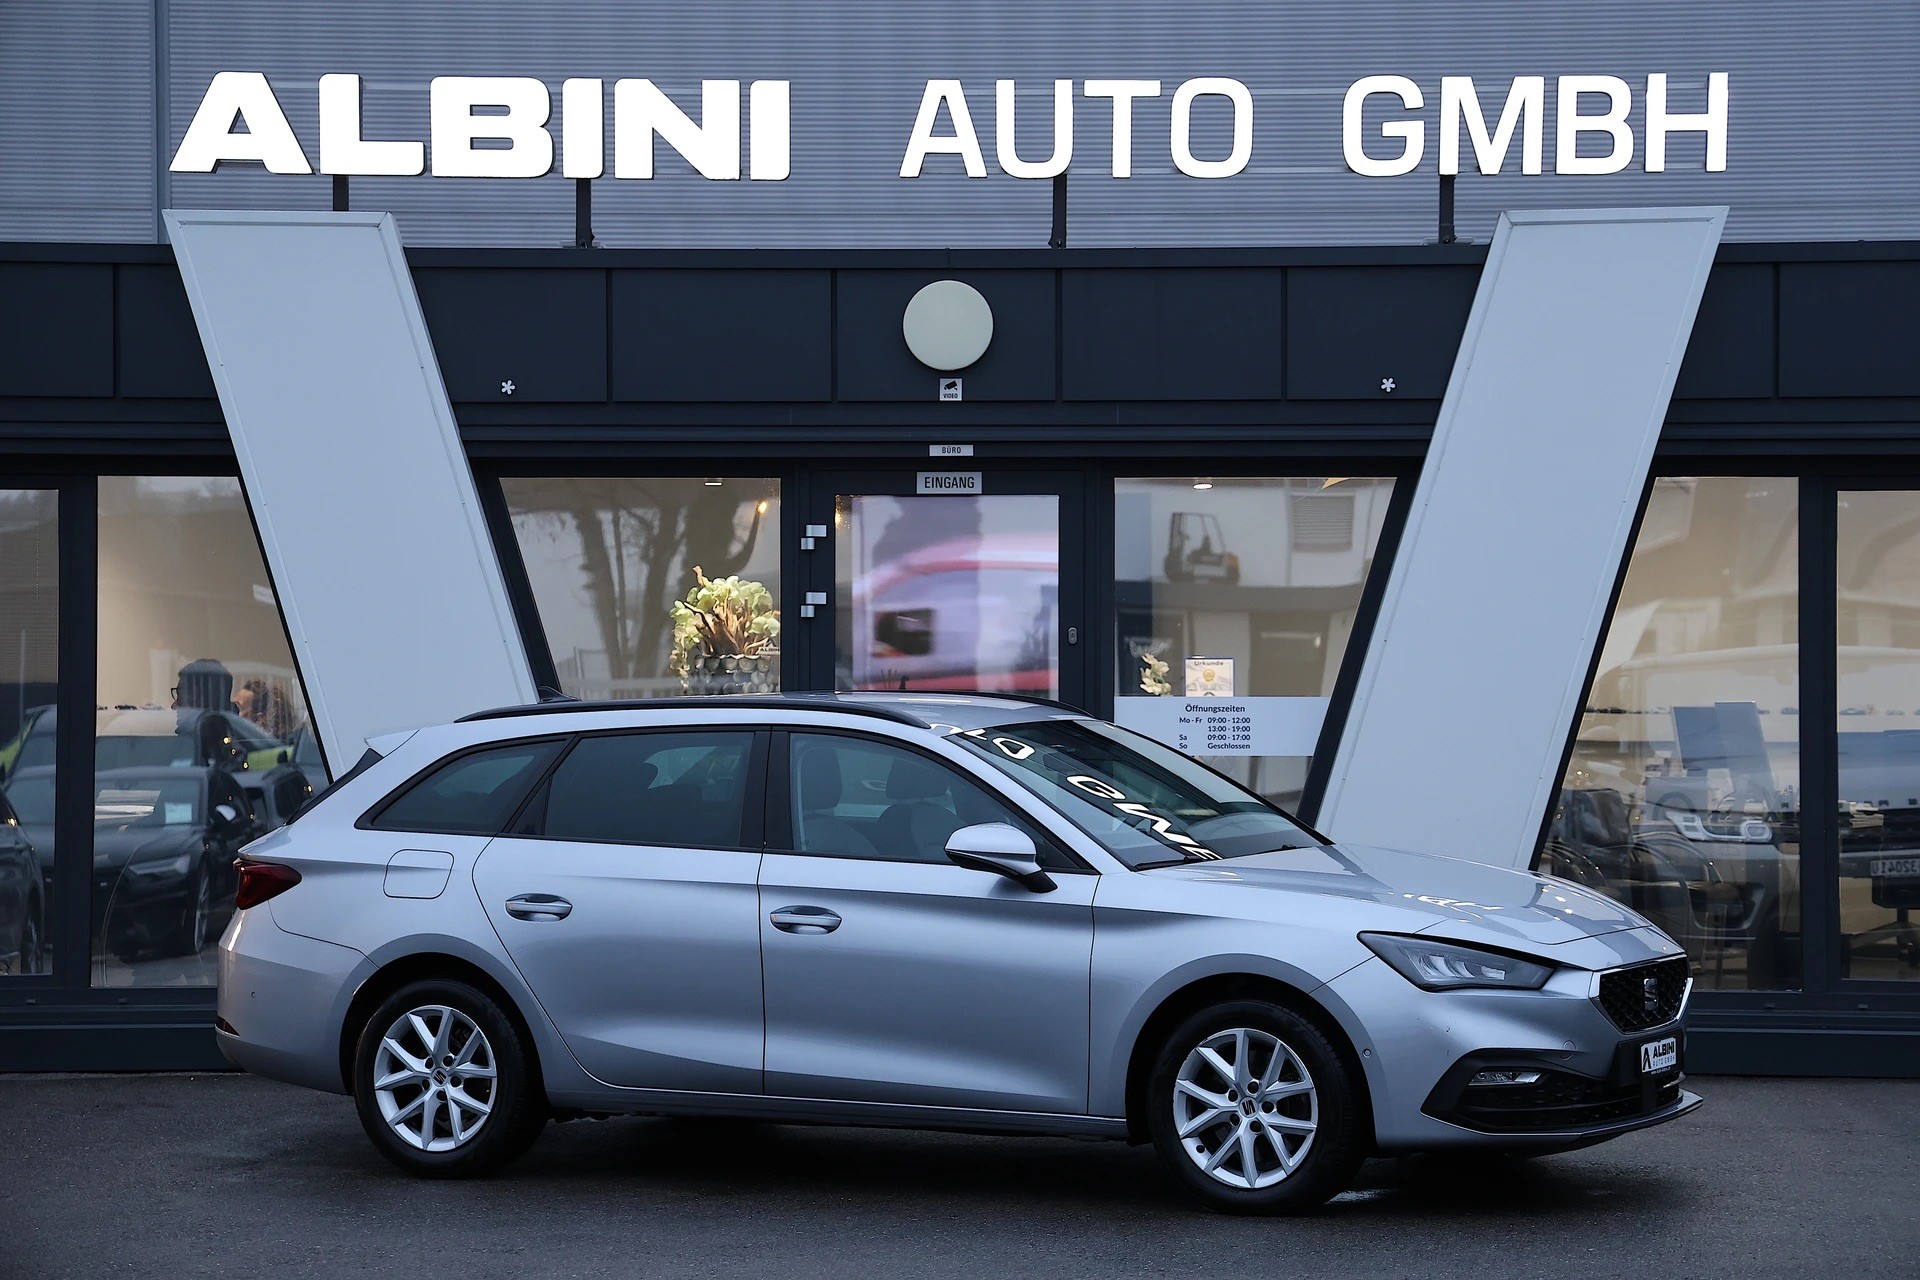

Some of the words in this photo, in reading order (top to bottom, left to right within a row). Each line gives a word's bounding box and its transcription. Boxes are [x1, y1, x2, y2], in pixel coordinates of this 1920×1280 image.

[168, 71, 792, 181] ALBINI
[899, 76, 1255, 179] AUTO
[1341, 72, 1730, 177] GMBH
[941, 446, 962, 454] BÜRO
[924, 476, 975, 489] EINGANG
[1185, 703, 1246, 713] Öffnungszeiten
[1653, 1041, 1675, 1058] ALBINI
